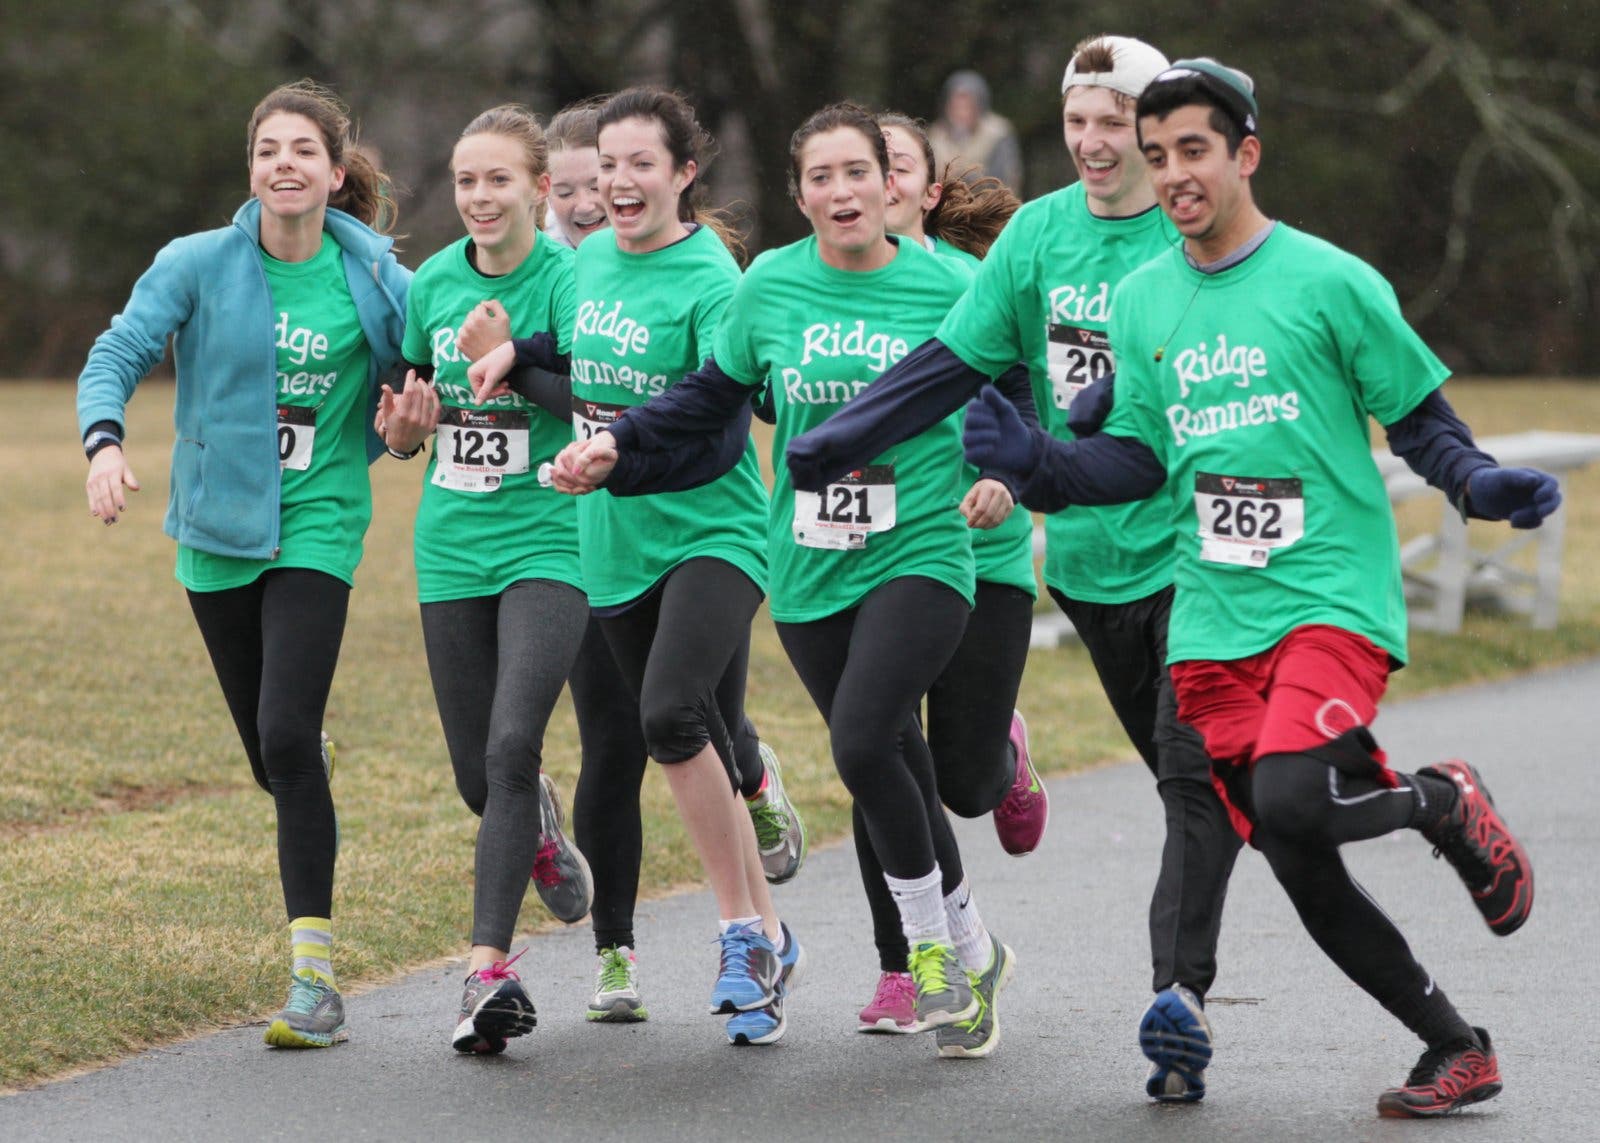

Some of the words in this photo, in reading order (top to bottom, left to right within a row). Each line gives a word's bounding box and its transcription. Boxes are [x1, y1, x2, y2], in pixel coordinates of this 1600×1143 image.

[1048, 282, 1110, 325] Rid
[275, 312, 329, 365] dge
[573, 300, 650, 356] Ridge
[800, 320, 909, 373] Ridge
[276, 371, 338, 395] ners
[571, 358, 667, 397] unners
[781, 367, 870, 405] Runn
[1065, 348, 1113, 384] 20
[1172, 334, 1268, 399] Ridge
[1165, 391, 1301, 447] Runners
[278, 426, 297, 461] 0
[453, 429, 509, 467] 123
[817, 486, 872, 524] 121
[1211, 498, 1282, 539] 262
